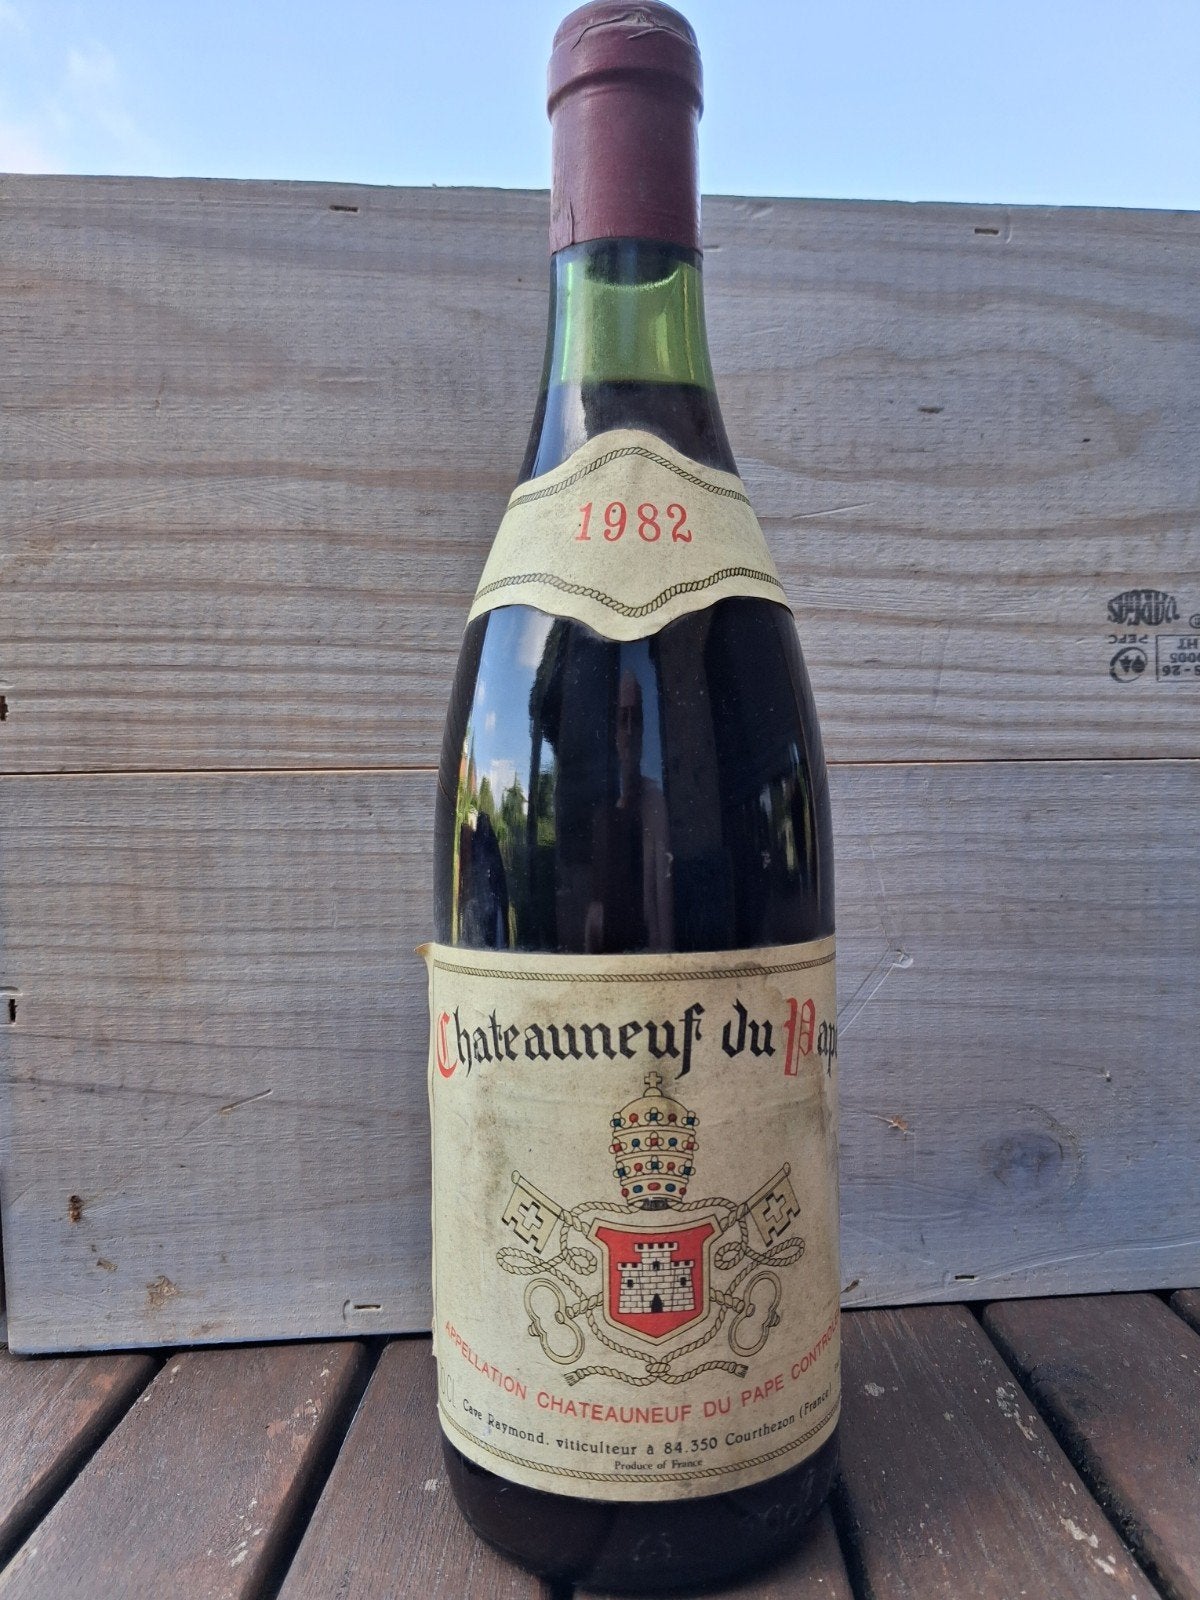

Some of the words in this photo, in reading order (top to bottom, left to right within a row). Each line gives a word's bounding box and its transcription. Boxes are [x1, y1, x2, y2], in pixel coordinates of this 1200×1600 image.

[575, 501, 693, 542] 1982
[1108, 634, 1149, 644] PEFC
[1177, 638, 1198, 650] HT
[436, 1002, 706, 1080] Chateauneuf
[721, 998, 776, 1059] du
[784, 997, 838, 1079] Pap
[445, 1321, 528, 1400] APPELLATION
[536, 1391, 692, 1424] CHATEAUNEUF
[703, 1396, 731, 1418] DU
[741, 1373, 785, 1407] PAPE
[462, 1398, 483, 1420] Cave
[556, 1438, 637, 1455] viticulteur
[799, 1381, 832, 1418] (France)
[614, 1460, 653, 1470] Produce
[657, 1460, 667, 1469] of
[671, 1459, 703, 1469] France
